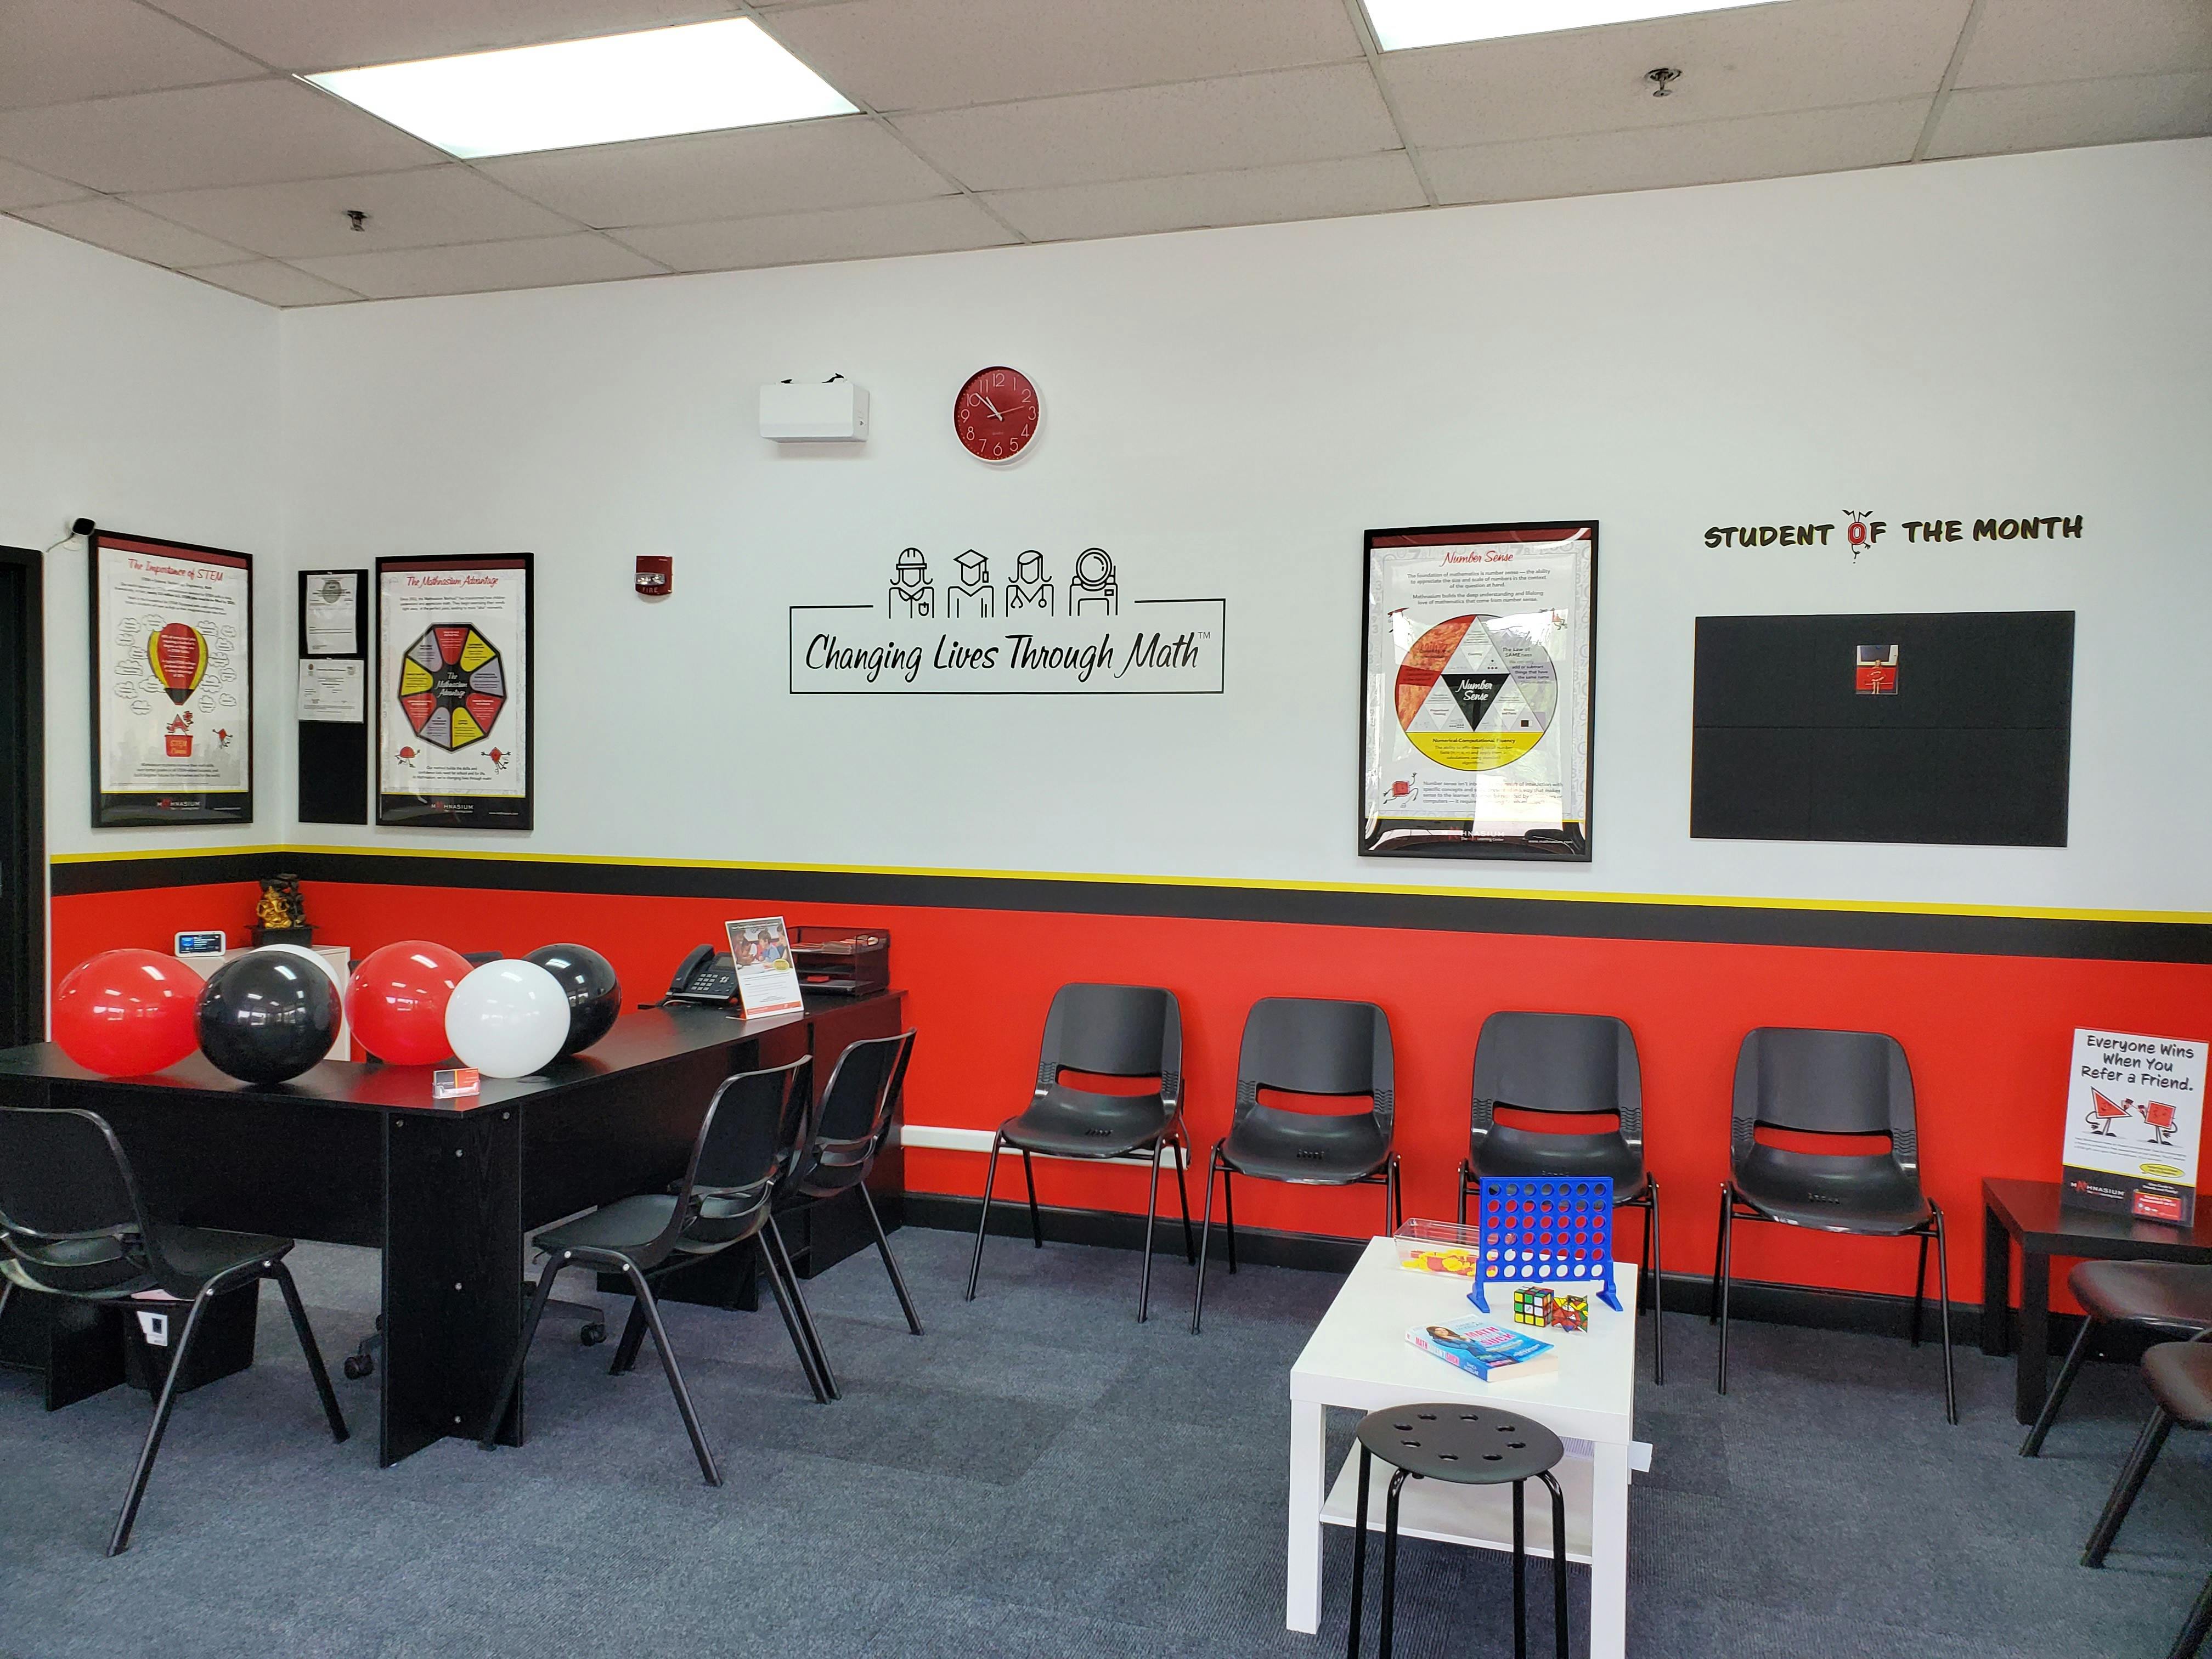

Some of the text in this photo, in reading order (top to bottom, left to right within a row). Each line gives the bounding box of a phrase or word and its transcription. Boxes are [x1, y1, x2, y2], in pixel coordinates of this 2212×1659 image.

[980, 379, 988, 393] 11
[992, 373, 1005, 387] 12
[967, 393, 981, 407] 10
[1022, 389, 1031, 403] 2
[961, 409, 970, 424] 9
[1028, 406, 1036, 420] 3
[966, 426, 975, 441] 8
[1021, 424, 1030, 438] 4
[979, 439, 987, 453] 7
[993, 442, 1002, 456] 6
[1009, 438, 1019, 452] 5
[1704, 515, 2083, 548] STUDENT OF THE MONTH
[1439, 550, 1514, 567] Number Sense
[128, 558, 224, 582] The Importance of STEM
[407, 575, 498, 588] The Mathnasium Advantage
[806, 634, 922, 682] Changing
[934, 634, 998, 669] Lives
[1005, 634, 1112, 682] Through
[1455, 679, 1492, 693] Number
[1463, 690, 1488, 701] Sense
[431, 802, 473, 811] MHNASIUM
[2087, 1035, 2194, 1059] Everyone Wins
[2103, 1053, 2173, 1072] When You
[2081, 1065, 2193, 1091] Refer a Friend.
[1464, 1327, 1499, 1339] MATH
[1481, 1333, 1516, 1345] SUCK
[1415, 1337, 1428, 1350] MATH
